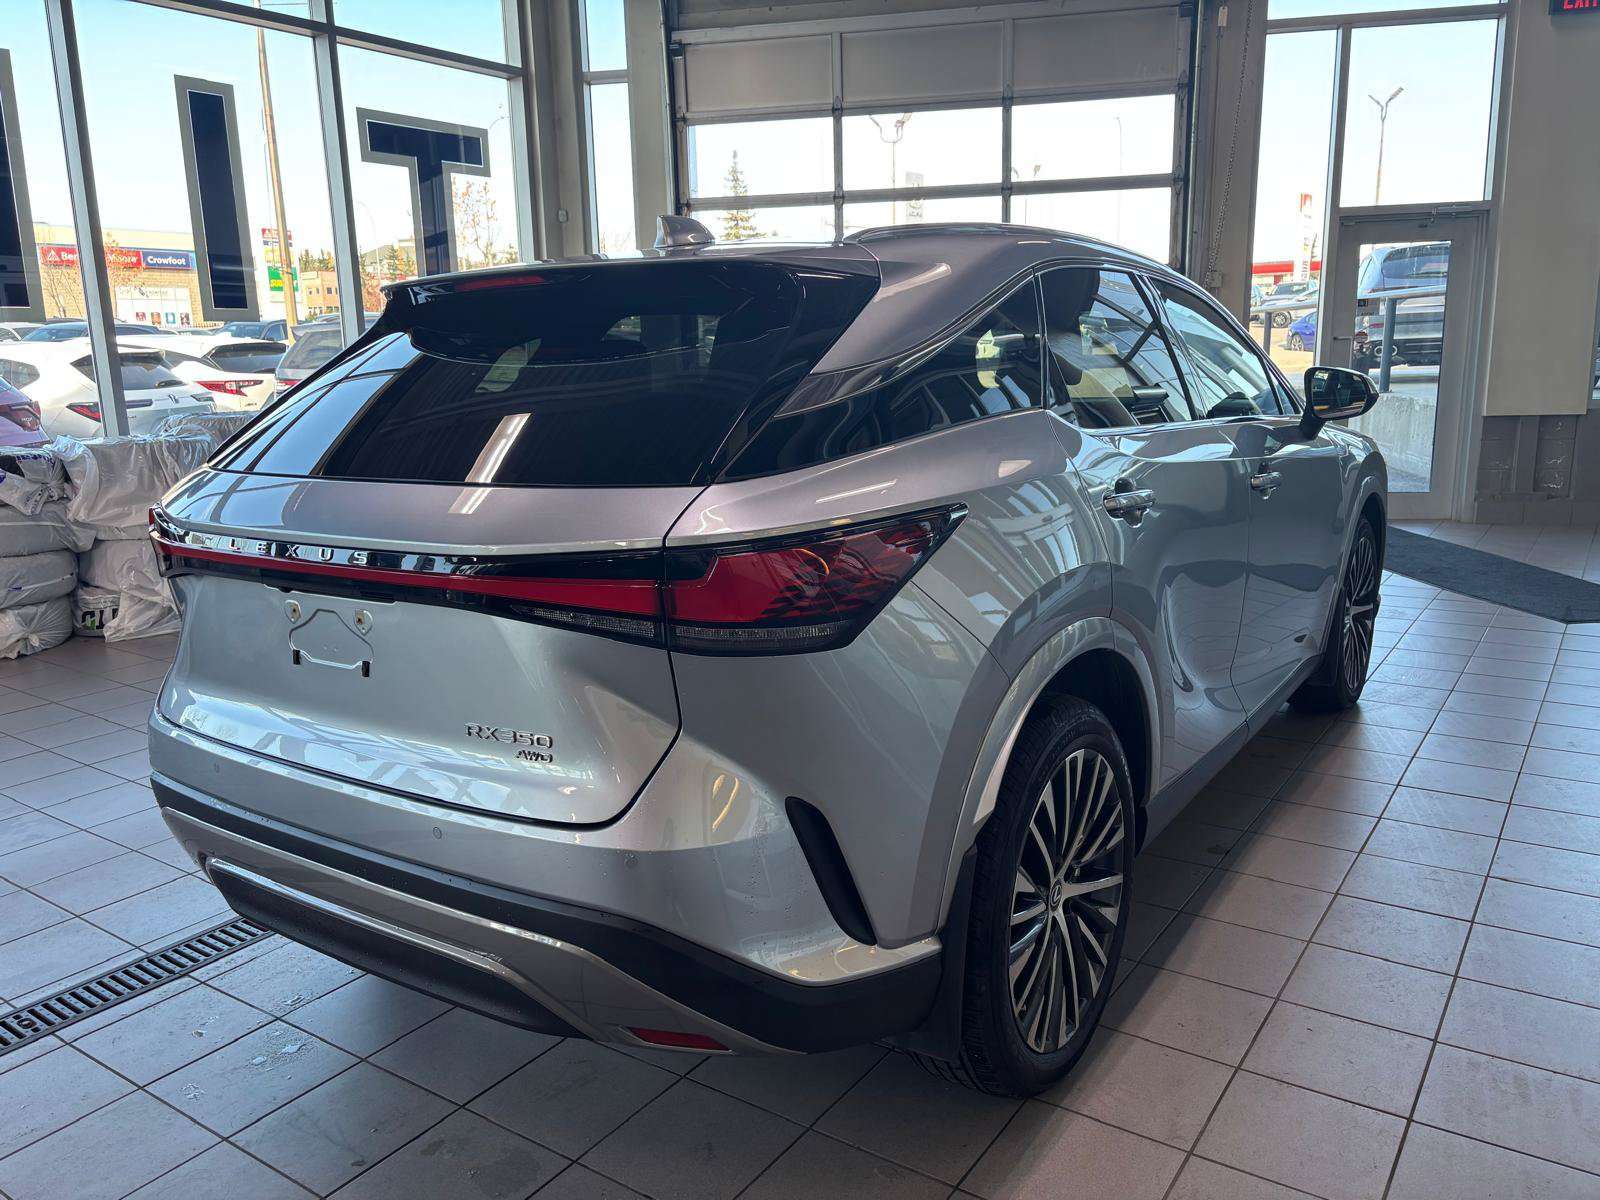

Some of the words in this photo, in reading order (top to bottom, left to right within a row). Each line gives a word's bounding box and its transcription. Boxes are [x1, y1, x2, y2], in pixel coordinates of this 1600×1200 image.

[147, 256, 186, 266] Crowfoot
[228, 538, 369, 565] LEXUS
[464, 722, 553, 749] RX350
[516, 750, 553, 763] AWD
